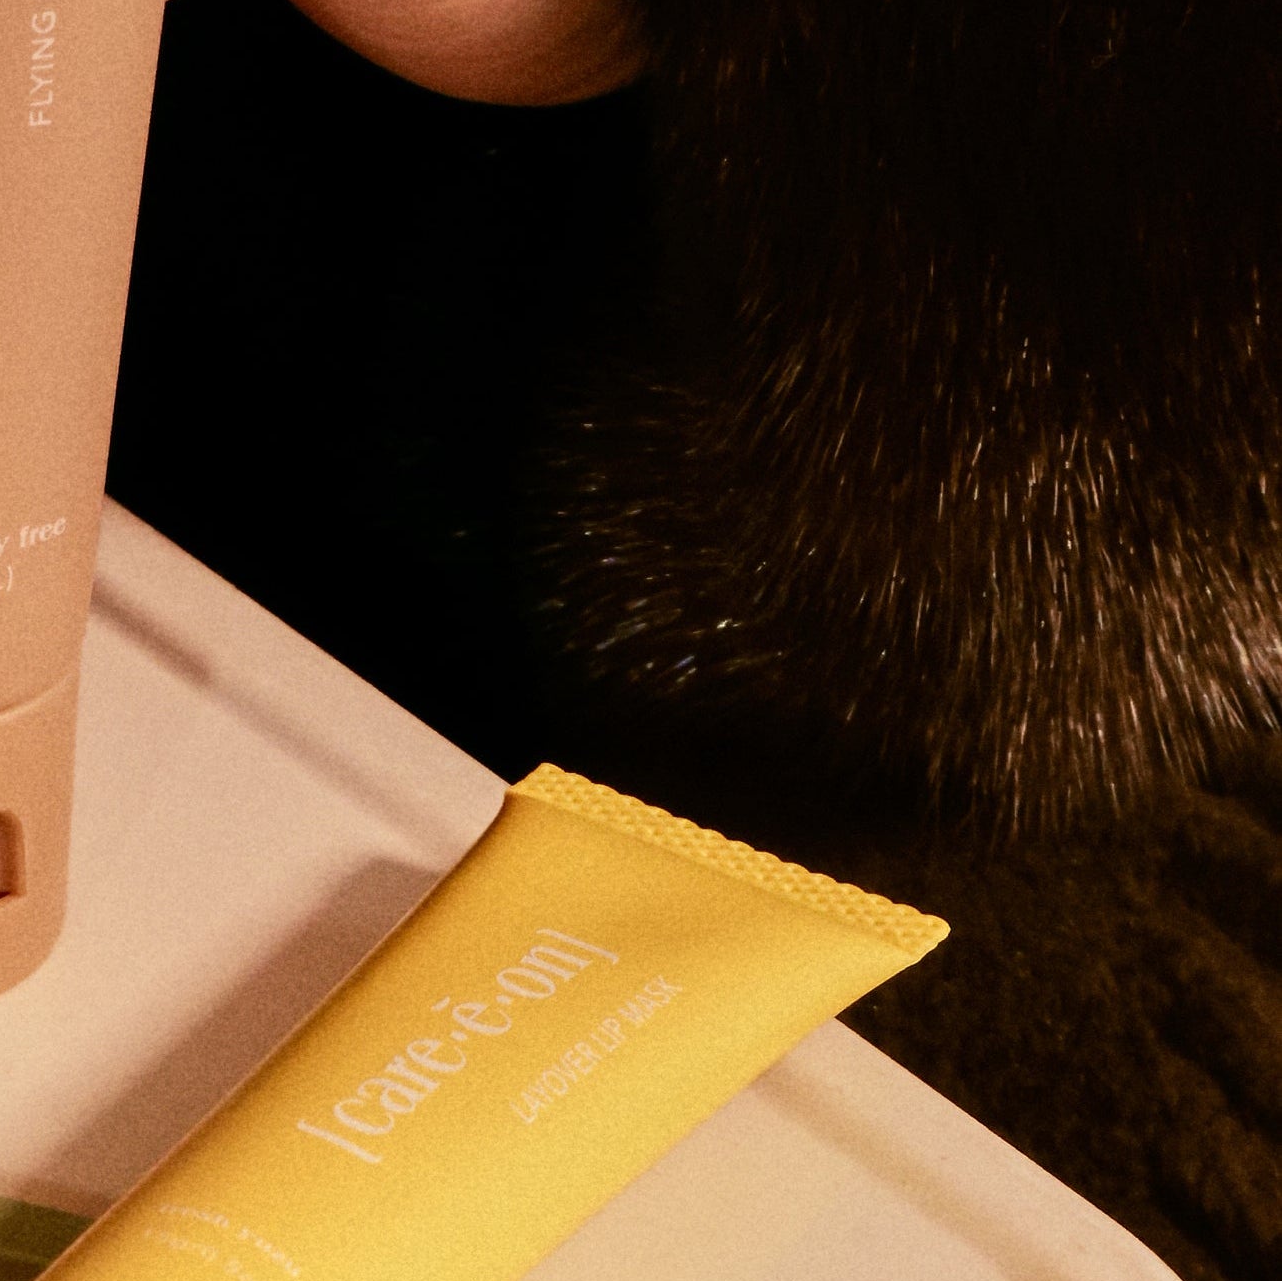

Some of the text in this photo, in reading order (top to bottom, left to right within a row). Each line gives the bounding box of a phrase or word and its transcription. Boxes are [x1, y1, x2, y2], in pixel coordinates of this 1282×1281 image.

[28, 9, 57, 128] FLYING
[18, 516, 68, 550] free
[509, 974, 685, 1126] LAYOVER LIP MASK
